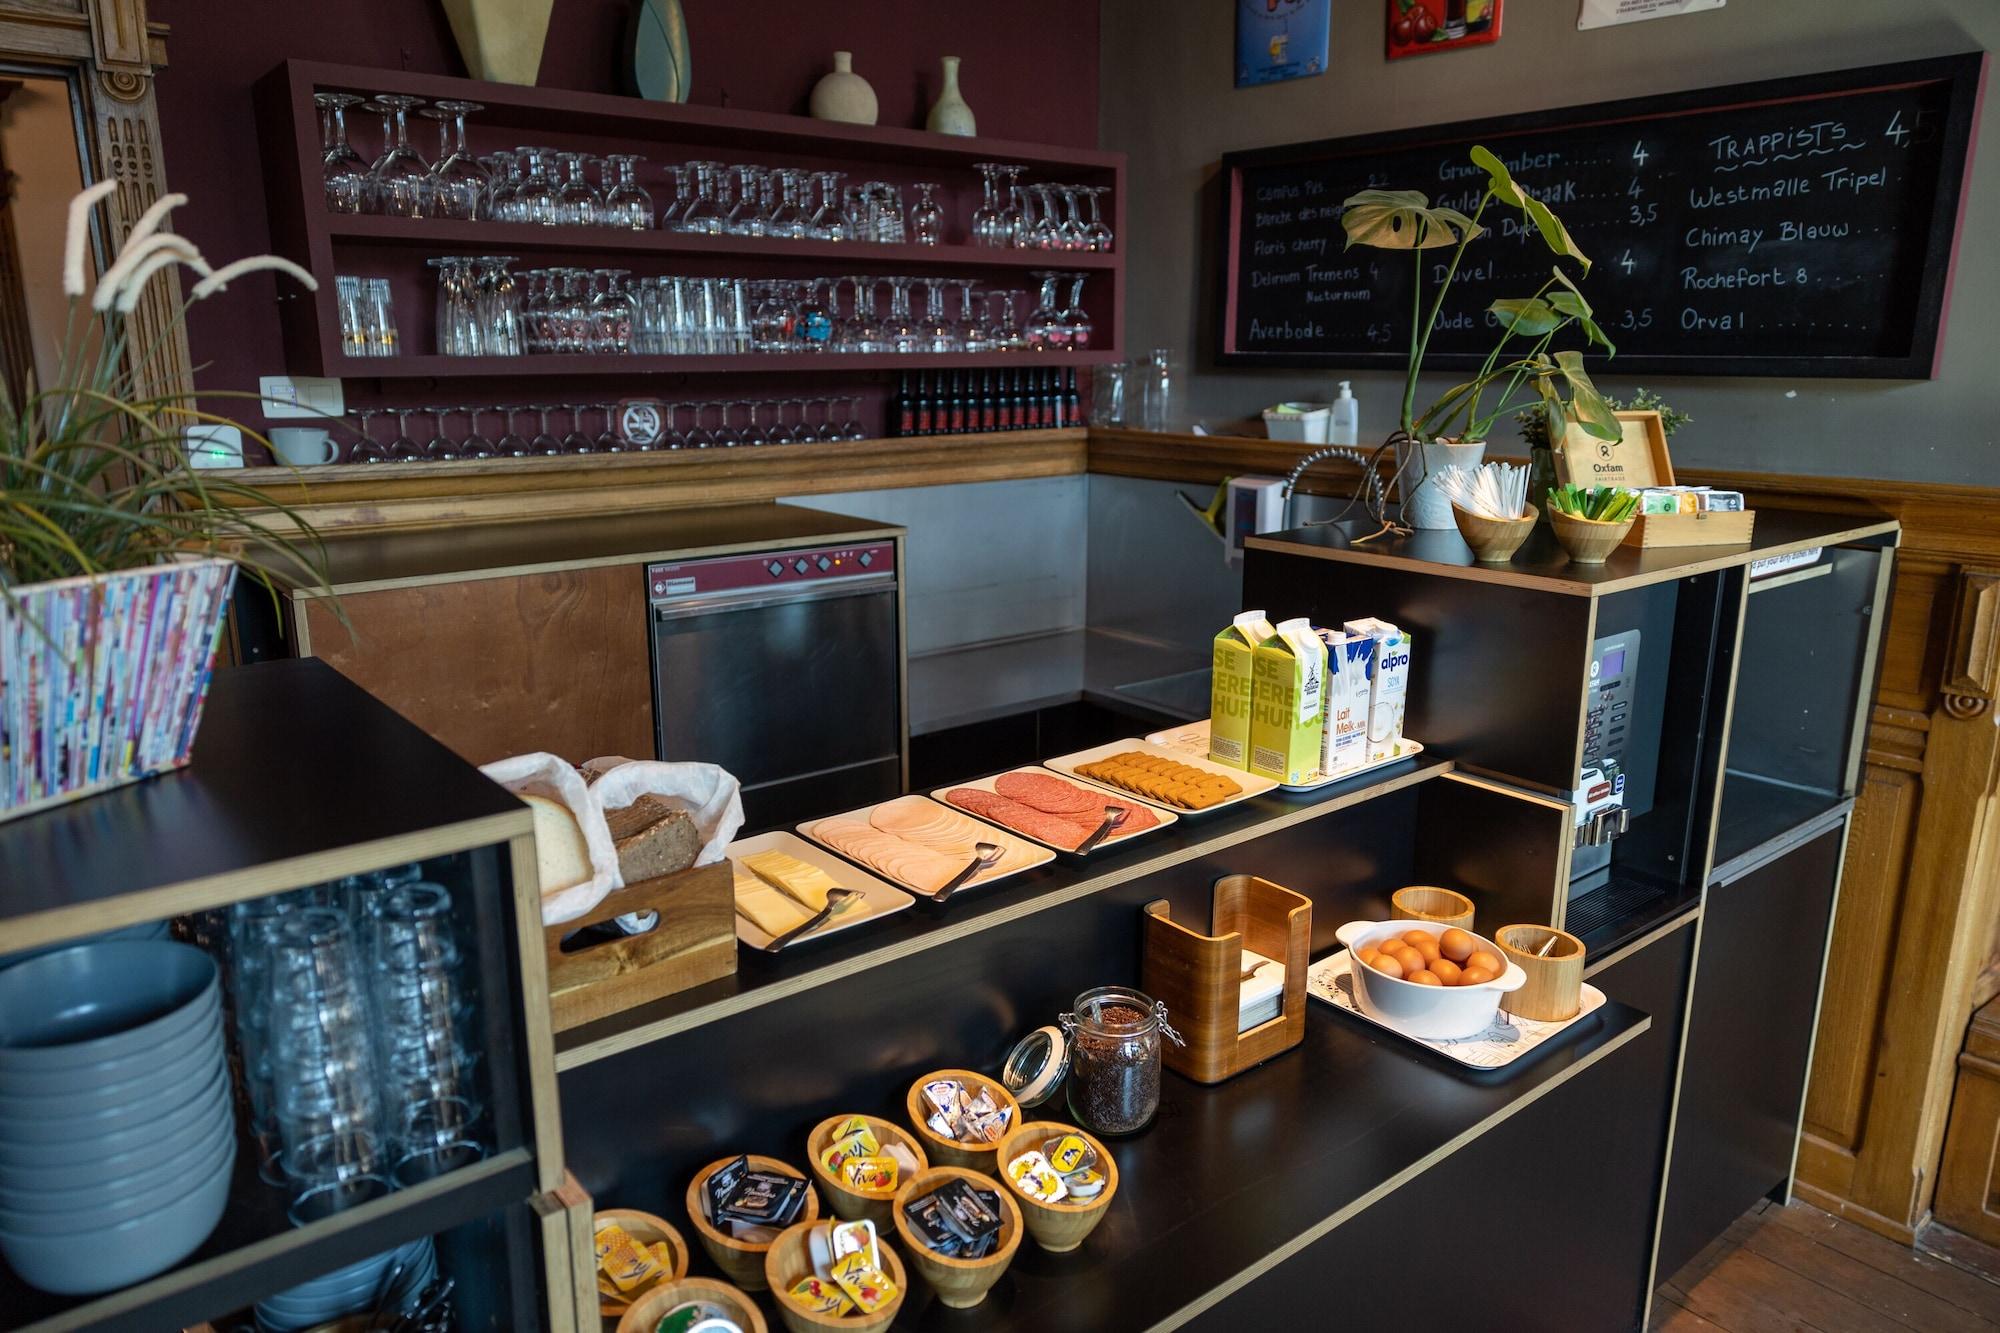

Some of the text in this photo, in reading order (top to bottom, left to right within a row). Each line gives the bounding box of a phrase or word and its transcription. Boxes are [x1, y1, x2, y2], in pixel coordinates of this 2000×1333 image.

[1507, 152, 1561, 173] mber
[1632, 139, 1649, 167] 4
[1627, 175, 1645, 200] 4
[1689, 166, 1887, 210] Westmalle Tripel
[1628, 202, 1660, 227] 3,5
[1685, 221, 1850, 255] Chimay Blauw
[1304, 264, 1360, 283] Tremens
[1620, 248, 1635, 275] 4
[1680, 266, 1808, 291] Rochefort 8
[1248, 317, 1326, 341] Averbode
[1620, 307, 1654, 332] 3,5
[1680, 307, 1745, 331] Orval
[1593, 463, 1624, 473] Oxfam
[1381, 652, 1409, 672] alpro
[1212, 671, 1250, 697] ERE
[1336, 706, 1351, 721] Lait
[1335, 720, 1355, 735] Melk
[846, 1161, 877, 1188] Viva
